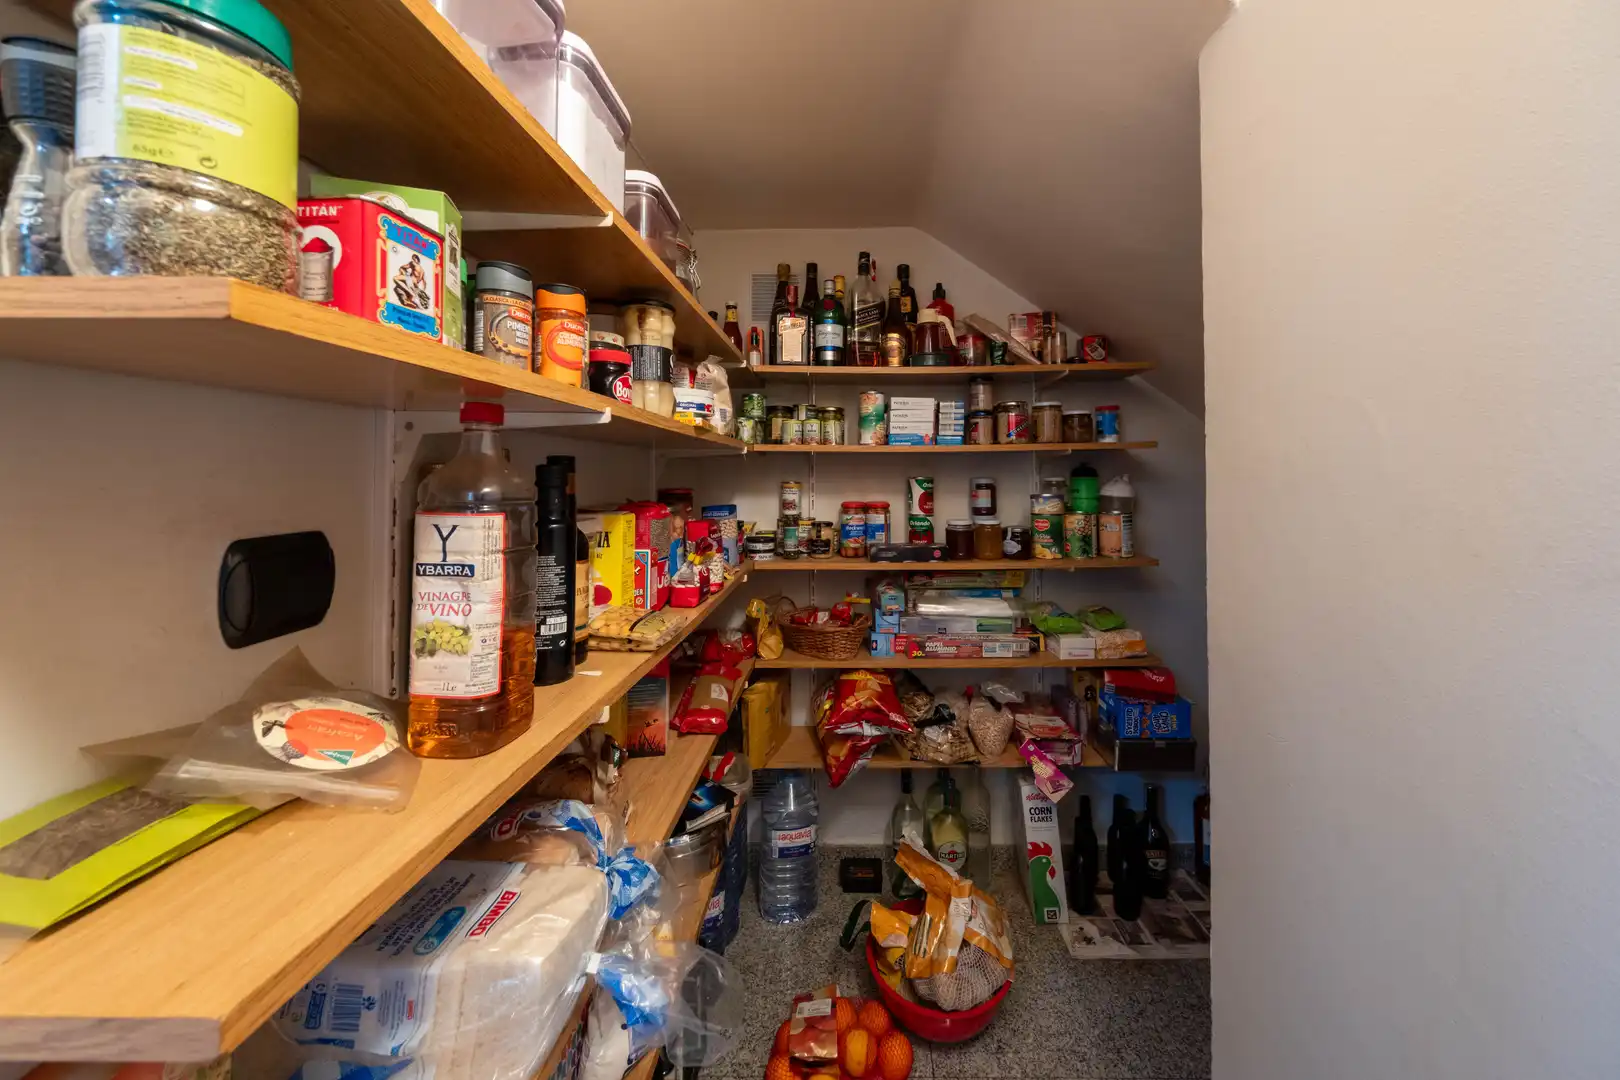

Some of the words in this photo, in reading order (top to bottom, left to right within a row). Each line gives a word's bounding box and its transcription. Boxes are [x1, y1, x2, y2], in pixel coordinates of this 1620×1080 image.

[417, 565, 471, 576] YBARRA
[418, 591, 472, 602] VINAGRE
[428, 604, 472, 617] VINO
[1029, 806, 1053, 816] CORN
[470, 889, 518, 937] BIMBO
